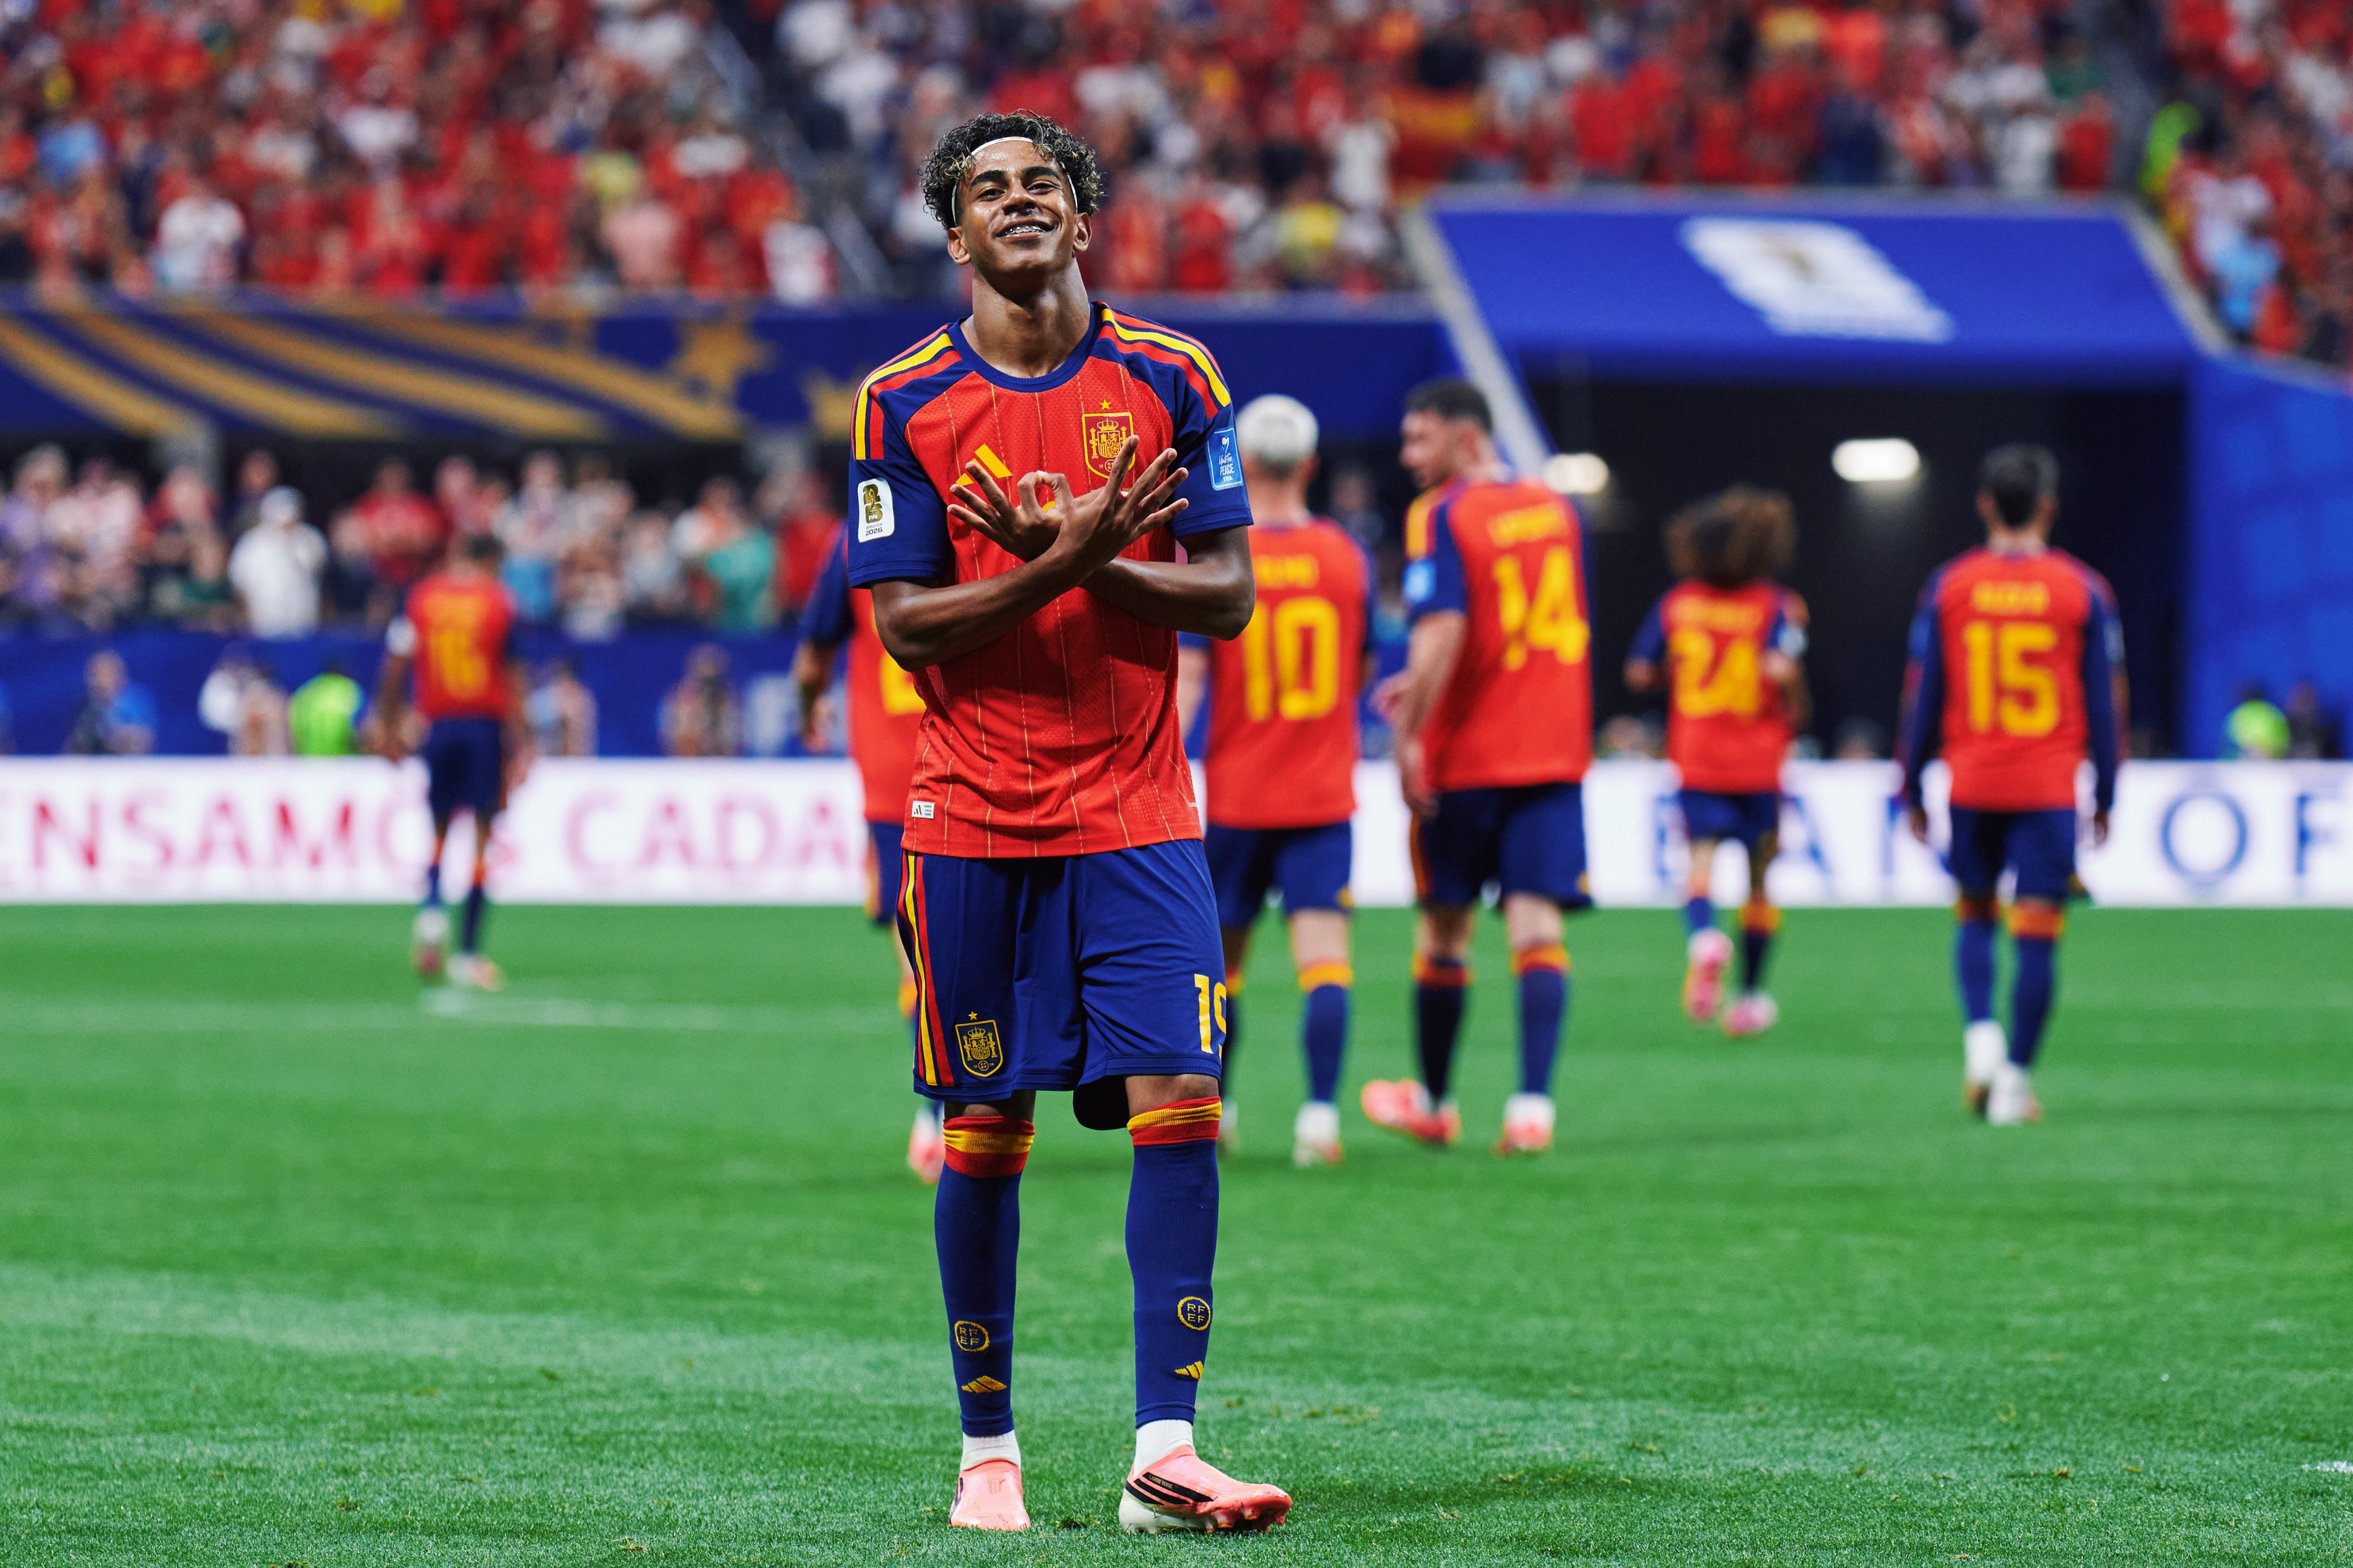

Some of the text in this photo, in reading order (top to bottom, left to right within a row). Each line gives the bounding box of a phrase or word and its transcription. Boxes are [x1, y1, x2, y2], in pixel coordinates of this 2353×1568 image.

[1220, 464, 1235, 476] PEACE
[866, 527, 883, 536] 2026
[1494, 544, 1590, 671] 14
[1242, 595, 1338, 723] 10
[1669, 628, 1762, 721] 24
[1963, 620, 2060, 739] 15
[563, 790, 853, 882] CADA
[2158, 788, 2351, 885] OF
